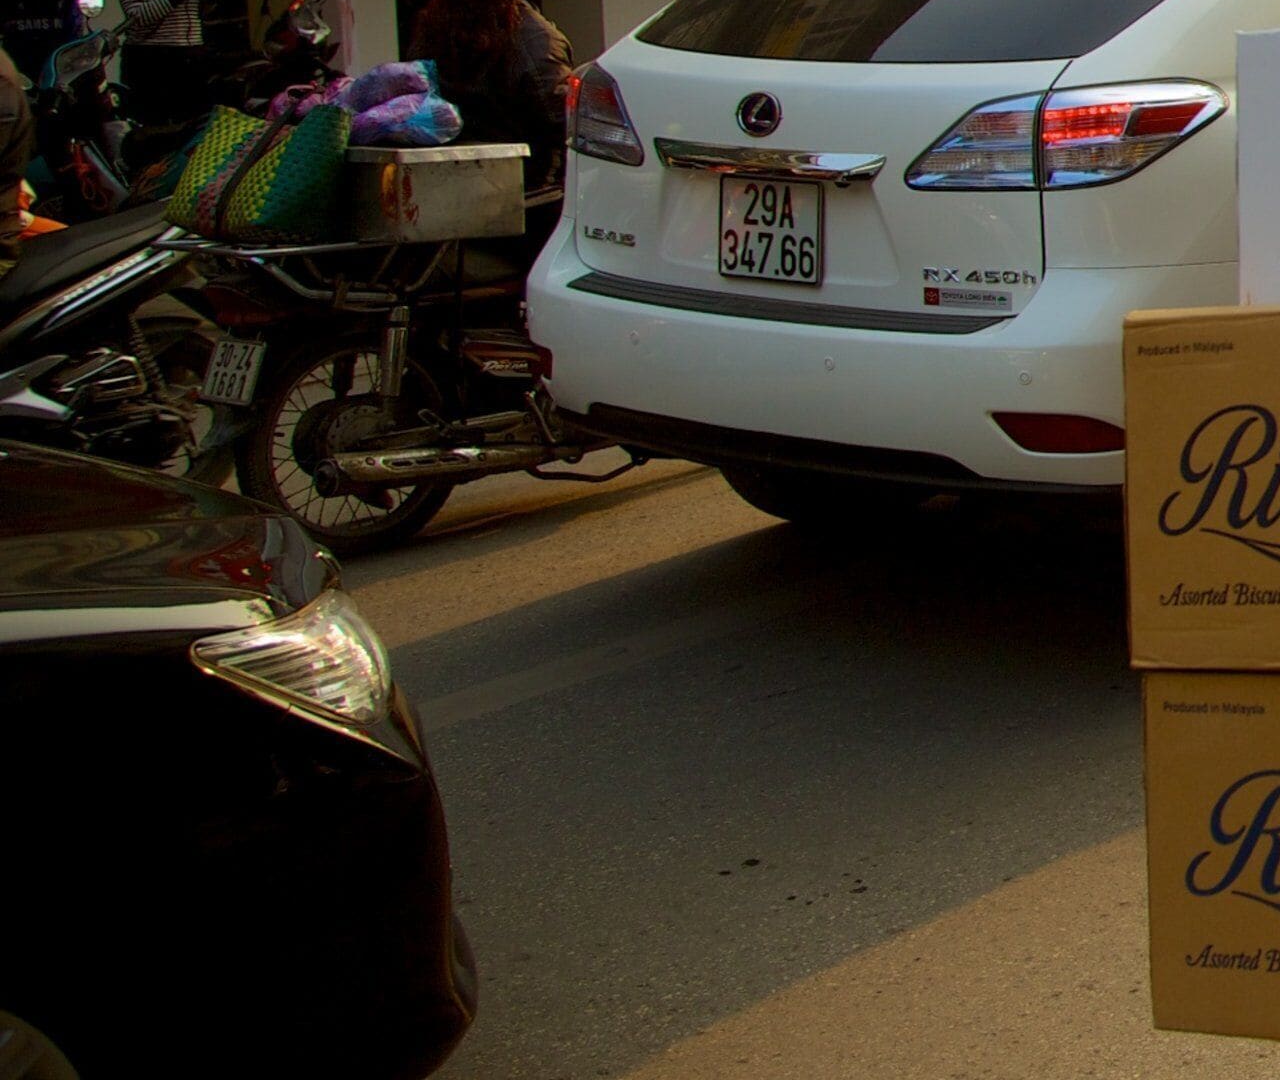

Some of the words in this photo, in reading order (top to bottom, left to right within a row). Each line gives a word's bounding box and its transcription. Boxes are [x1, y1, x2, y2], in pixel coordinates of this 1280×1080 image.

[743, 184, 794, 229] 29A
[583, 225, 636, 247] LEXUS
[723, 230, 815, 278] 347.66
[923, 267, 960, 283] RX
[965, 270, 1037, 285] 450h
[1137, 344, 1181, 357] Produced
[1193, 341, 1234, 354] Malaysia
[1160, 583, 1229, 606] Assorted
[1163, 701, 1208, 714] Produced
[1211, 702, 1220, 714] in
[1222, 702, 1265, 715] Malaysia
[1185, 944, 1263, 970] Assorted
